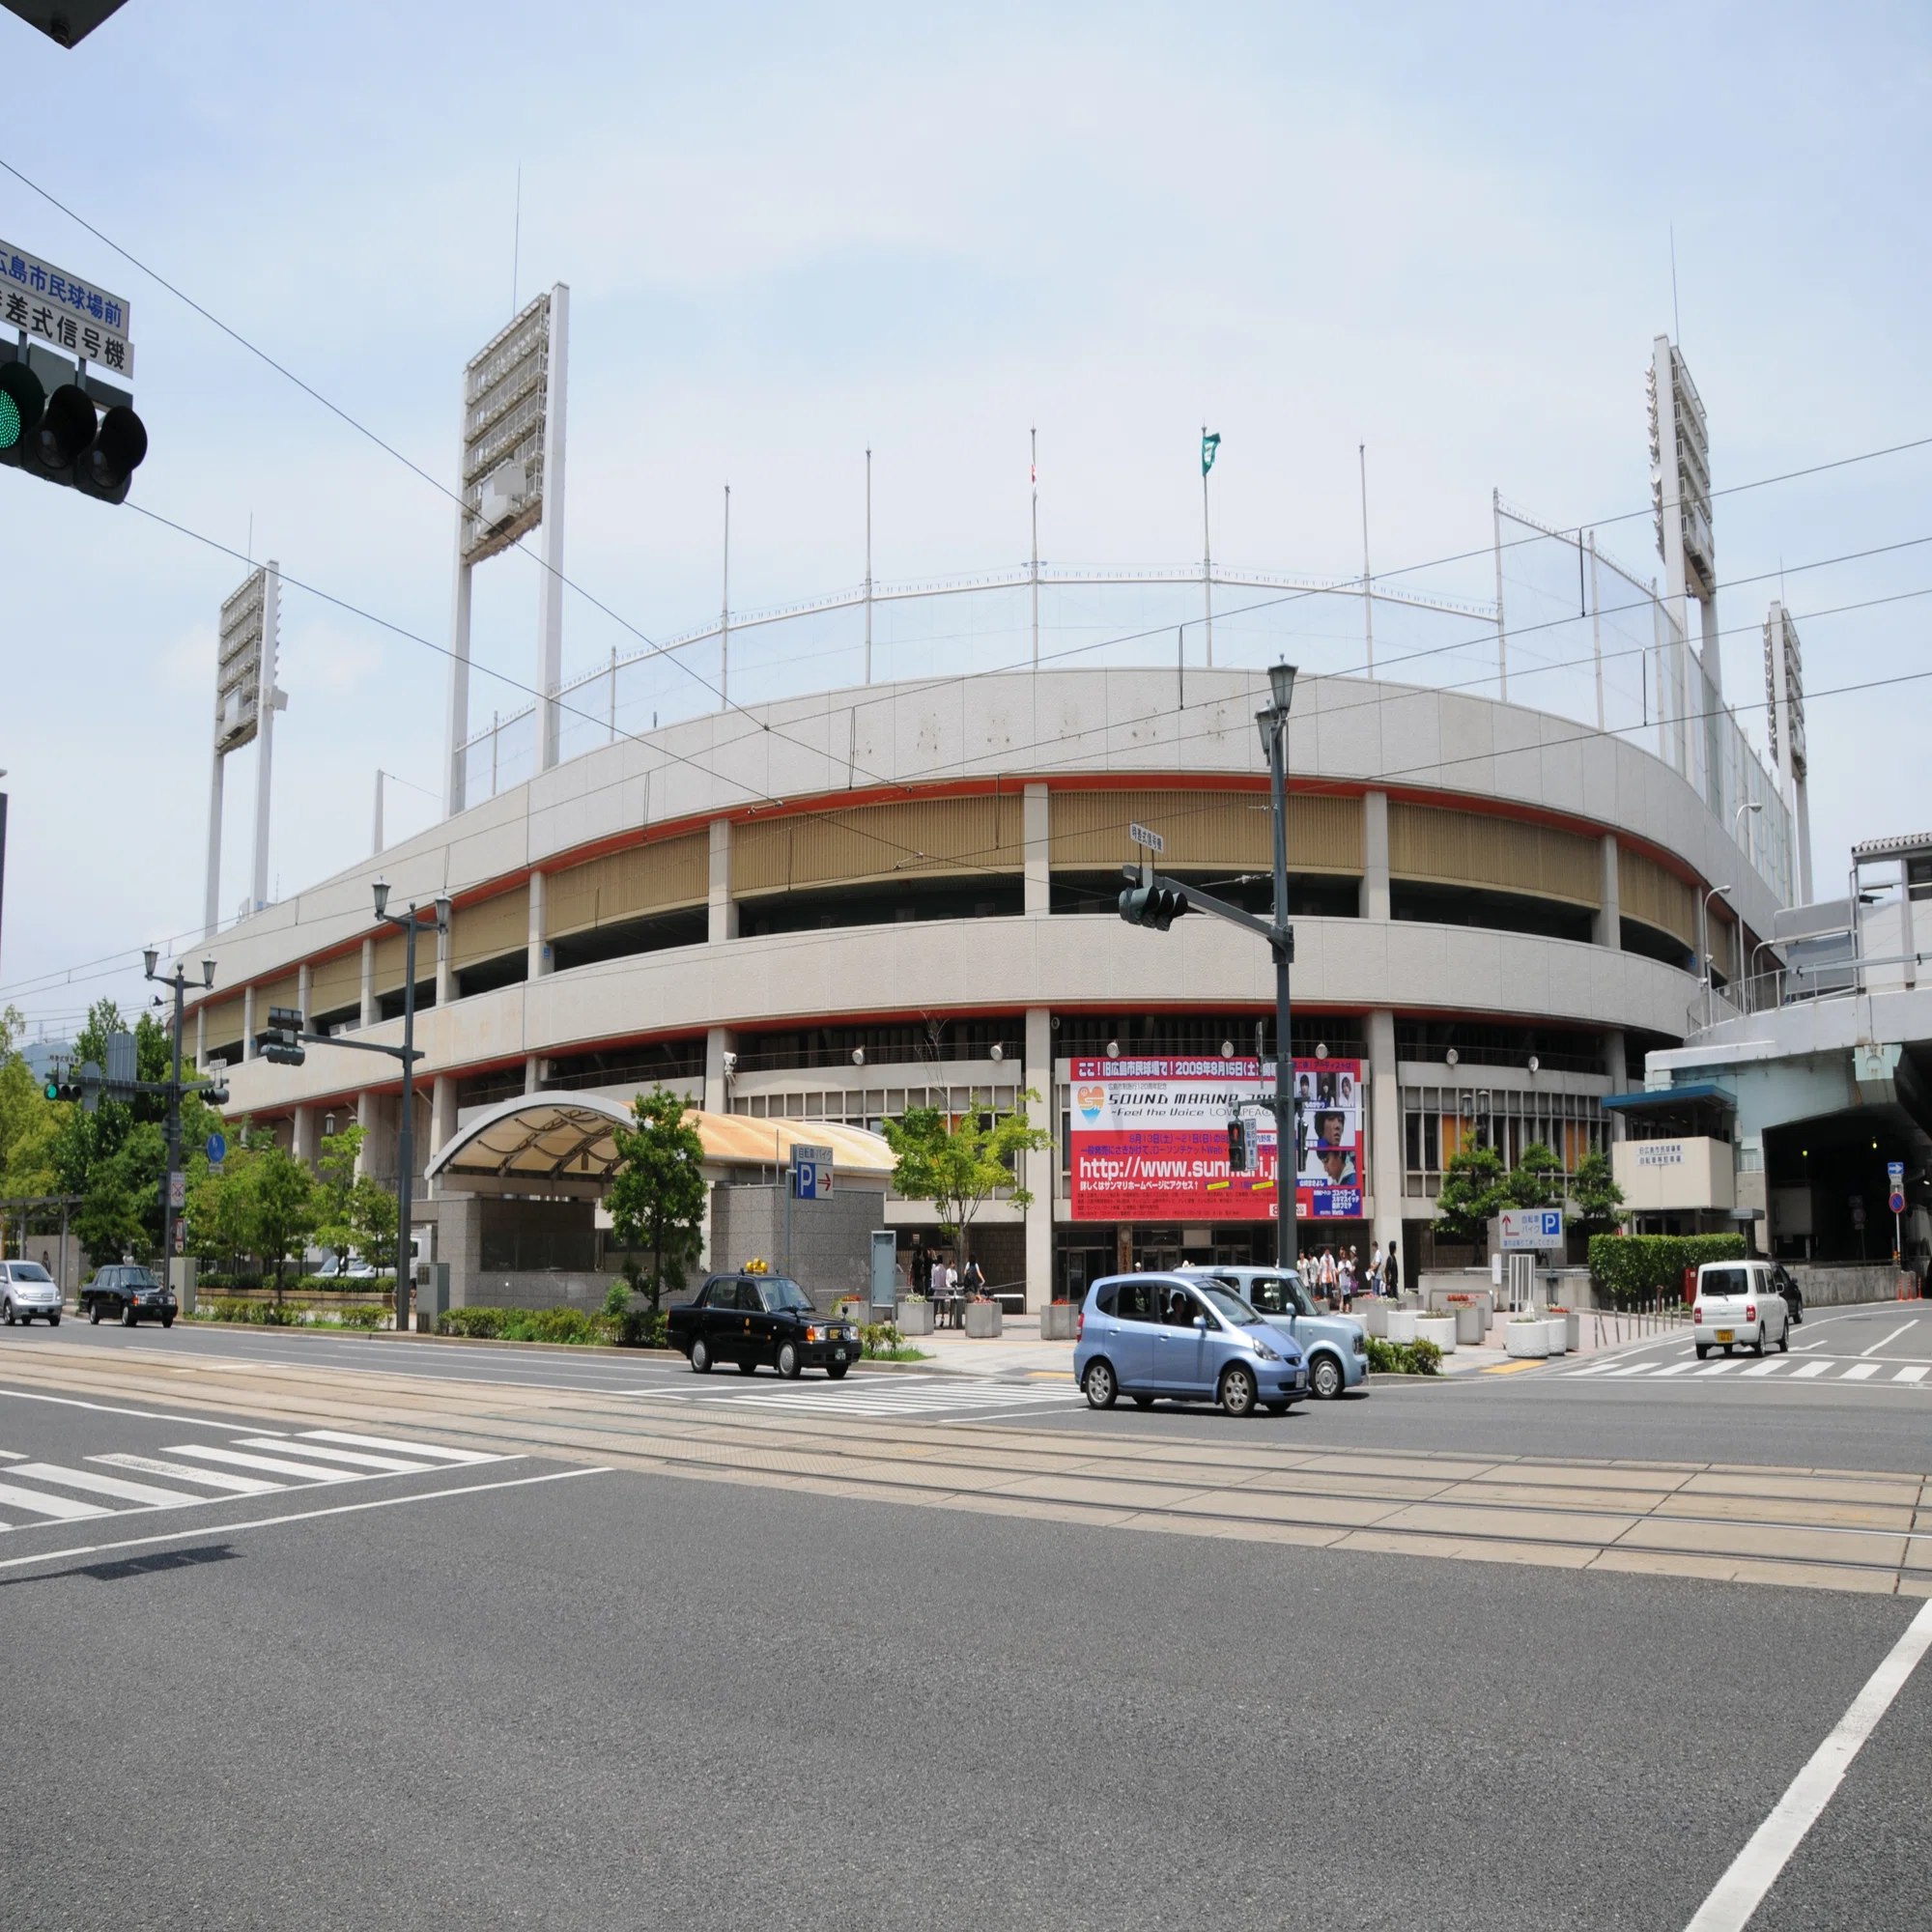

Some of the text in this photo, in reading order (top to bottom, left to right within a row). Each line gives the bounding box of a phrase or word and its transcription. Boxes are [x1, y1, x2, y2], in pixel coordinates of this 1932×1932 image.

[0, 290, 125, 371] 差式信号機
[1108, 1094, 1168, 1104] SOUND
[1147, 1108, 1167, 1117] the
[1170, 1108, 1205, 1117] Voice
[800, 1164, 812, 1196] P
[1545, 1214, 1556, 1234] P
